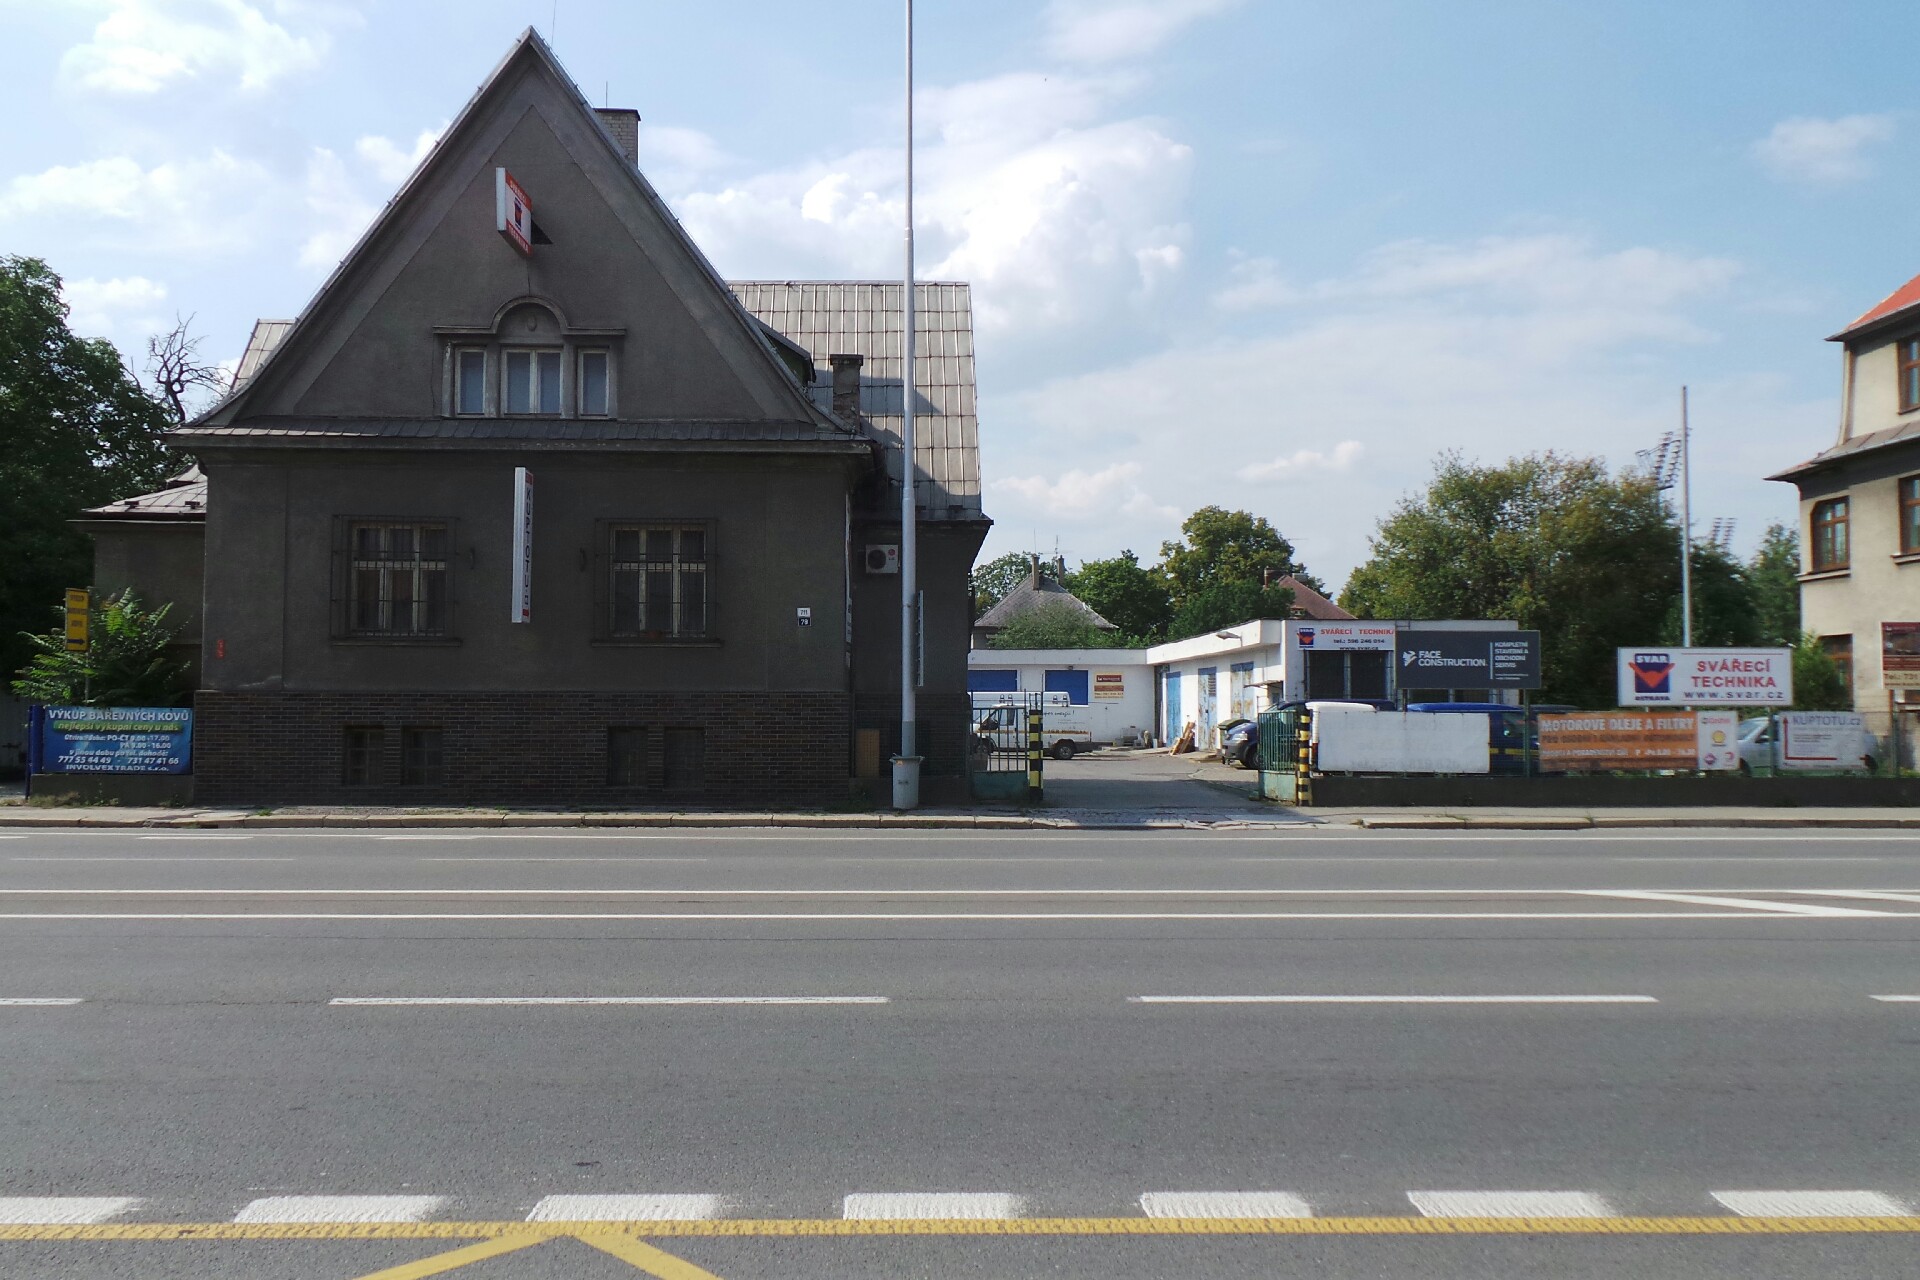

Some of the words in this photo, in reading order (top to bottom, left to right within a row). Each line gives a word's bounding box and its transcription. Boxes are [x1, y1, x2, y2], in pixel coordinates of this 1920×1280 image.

[1321, 627, 1352, 635] SVÁŘECÍ
[1418, 651, 1442, 659] FACE
[1697, 659, 1771, 673] SVÁŘECÍ
[1691, 676, 1777, 688] TECHNIKA
[1683, 691, 1784, 699] www.svar.cz
[49, 709, 87, 720] VÝKUP
[89, 710, 155, 720] BAREVNÝCH
[157, 710, 189, 721] KOVŮ
[58, 722, 94, 732] nejlepší
[96, 722, 132, 732] výkupní
[133, 724, 154, 732] ceny
[1609, 718, 1642, 731] OLEJE
[1645, 718, 1654, 731] A
[1656, 718, 1694, 730] FILTRY
